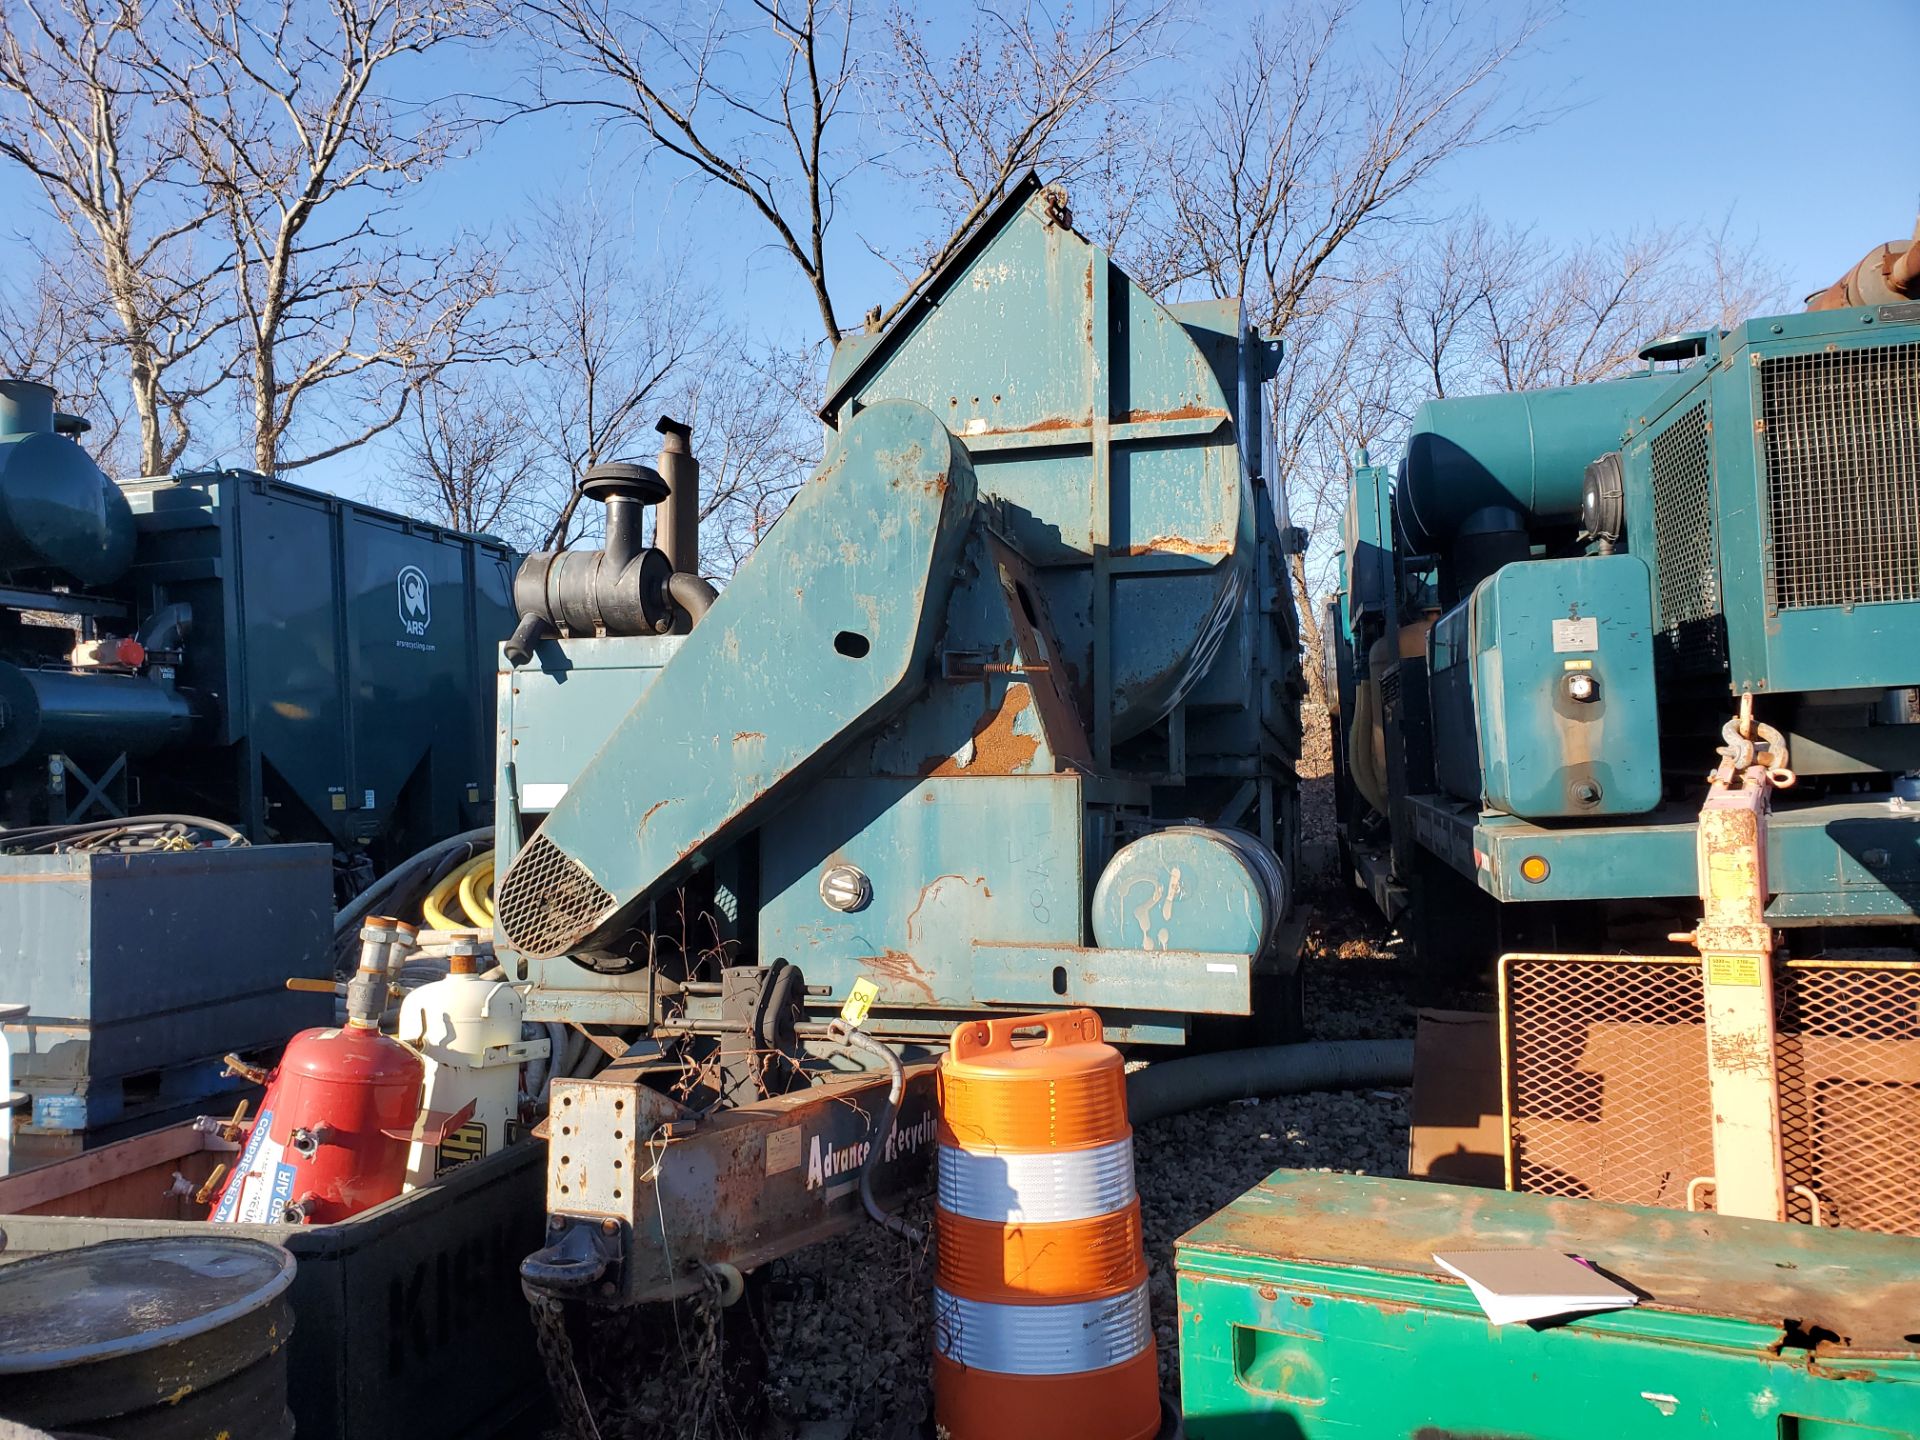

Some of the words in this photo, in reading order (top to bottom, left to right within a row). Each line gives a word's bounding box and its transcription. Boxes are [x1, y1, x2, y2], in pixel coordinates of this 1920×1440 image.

[406, 620, 424, 636] ARS
[396, 640, 436, 652] arsrecycling.com
[224, 1117, 270, 1206] COMPRESSED
[806, 1127, 878, 1191] Advance
[884, 1110, 938, 1163] Recyclin
[275, 1169, 292, 1198] AIR
